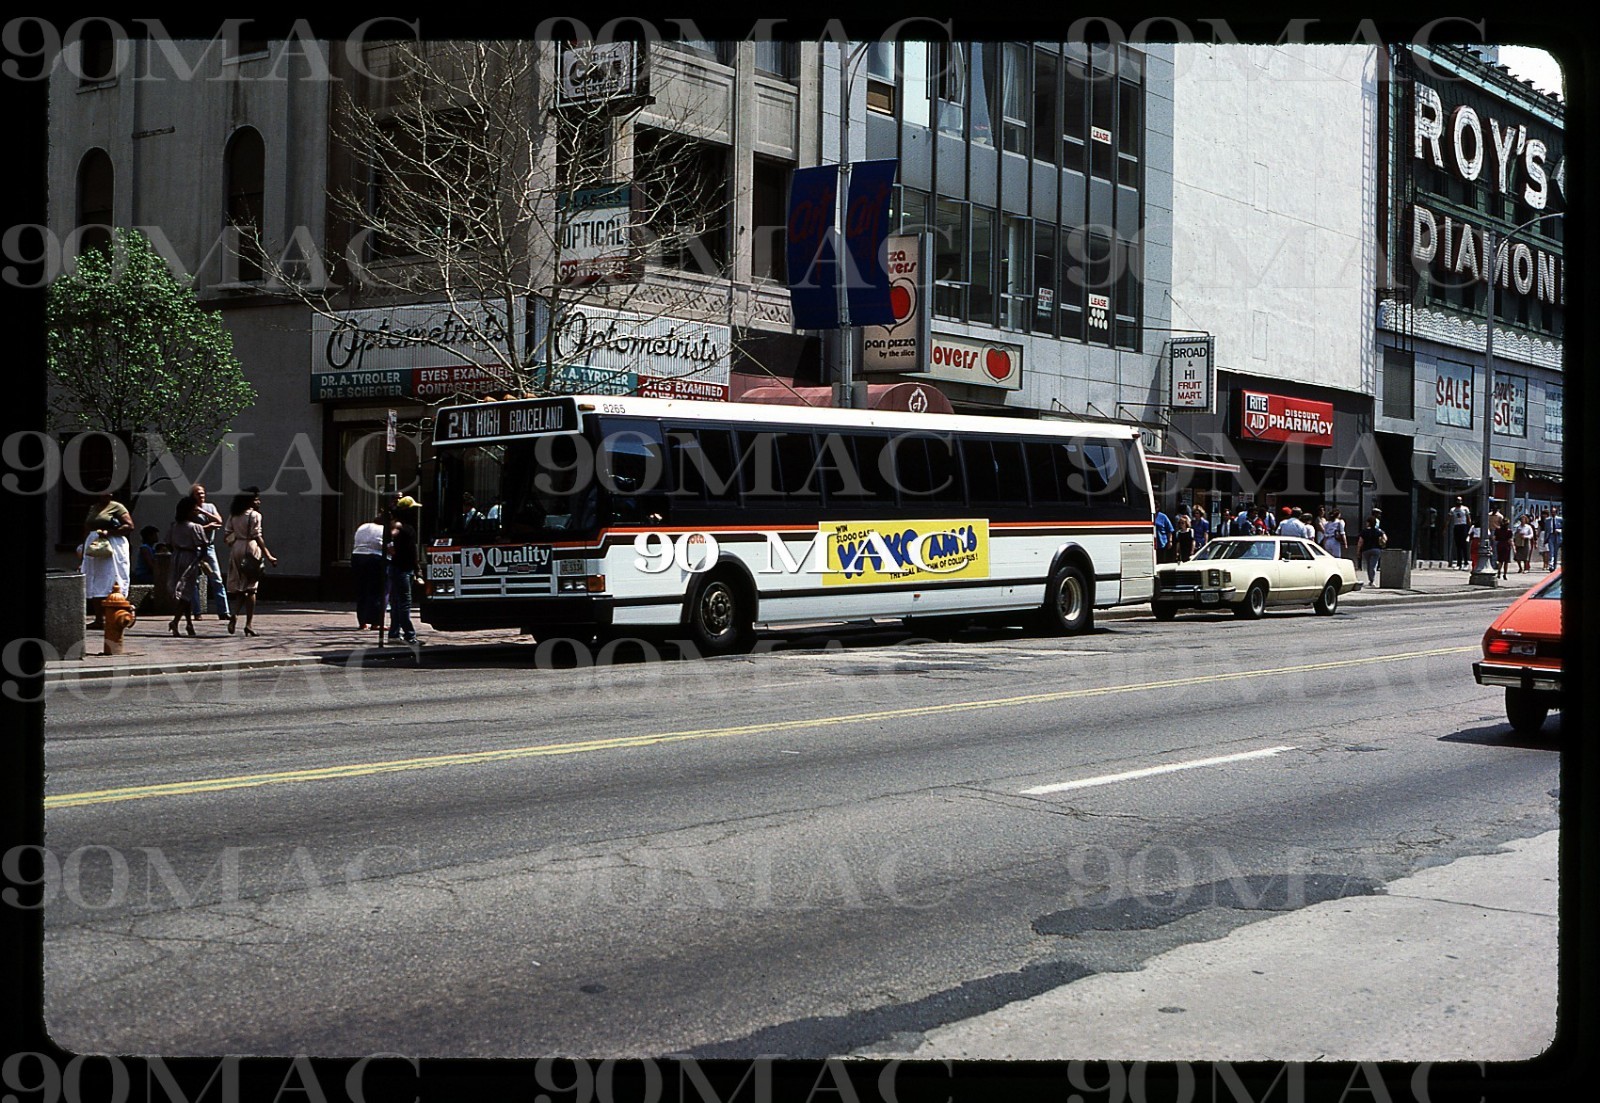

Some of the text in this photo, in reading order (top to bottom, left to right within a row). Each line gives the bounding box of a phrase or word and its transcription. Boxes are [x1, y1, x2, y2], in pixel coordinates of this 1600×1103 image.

[1414, 81, 1548, 210] ROY'S
[562, 218, 624, 249] OPTICAL
[1413, 204, 1564, 305] DIAMON
[1091, 297, 1107, 307] LEASE
[555, 311, 719, 367] Optometrists
[865, 338, 916, 350] pan pizza
[879, 351, 887, 359] by
[1174, 348, 1206, 359] BROAD
[321, 371, 401, 387] DR. A. TYROLER
[421, 369, 449, 381] EYES
[581, 368, 629, 386] TYROLER
[1184, 370, 1195, 380] HI
[347, 385, 402, 398] SCHECTER
[675, 381, 724, 397] EXAMINED
[1178, 381, 1202, 390] FRUIT
[1437, 375, 1470, 410] SALE
[603, 403, 626, 414] 8265
[1249, 395, 1267, 411] RITE
[449, 412, 460, 438] 2
[476, 410, 500, 436] HIGH
[509, 405, 563, 433] GRACELAND
[1250, 414, 1265, 429] AID
[1285, 409, 1320, 420] DISCOUNT
[1269, 413, 1334, 435] PHARMACY
[836, 525, 848, 534] WIN
[486, 545, 551, 573] Quality
[433, 567, 454, 578] 8265
